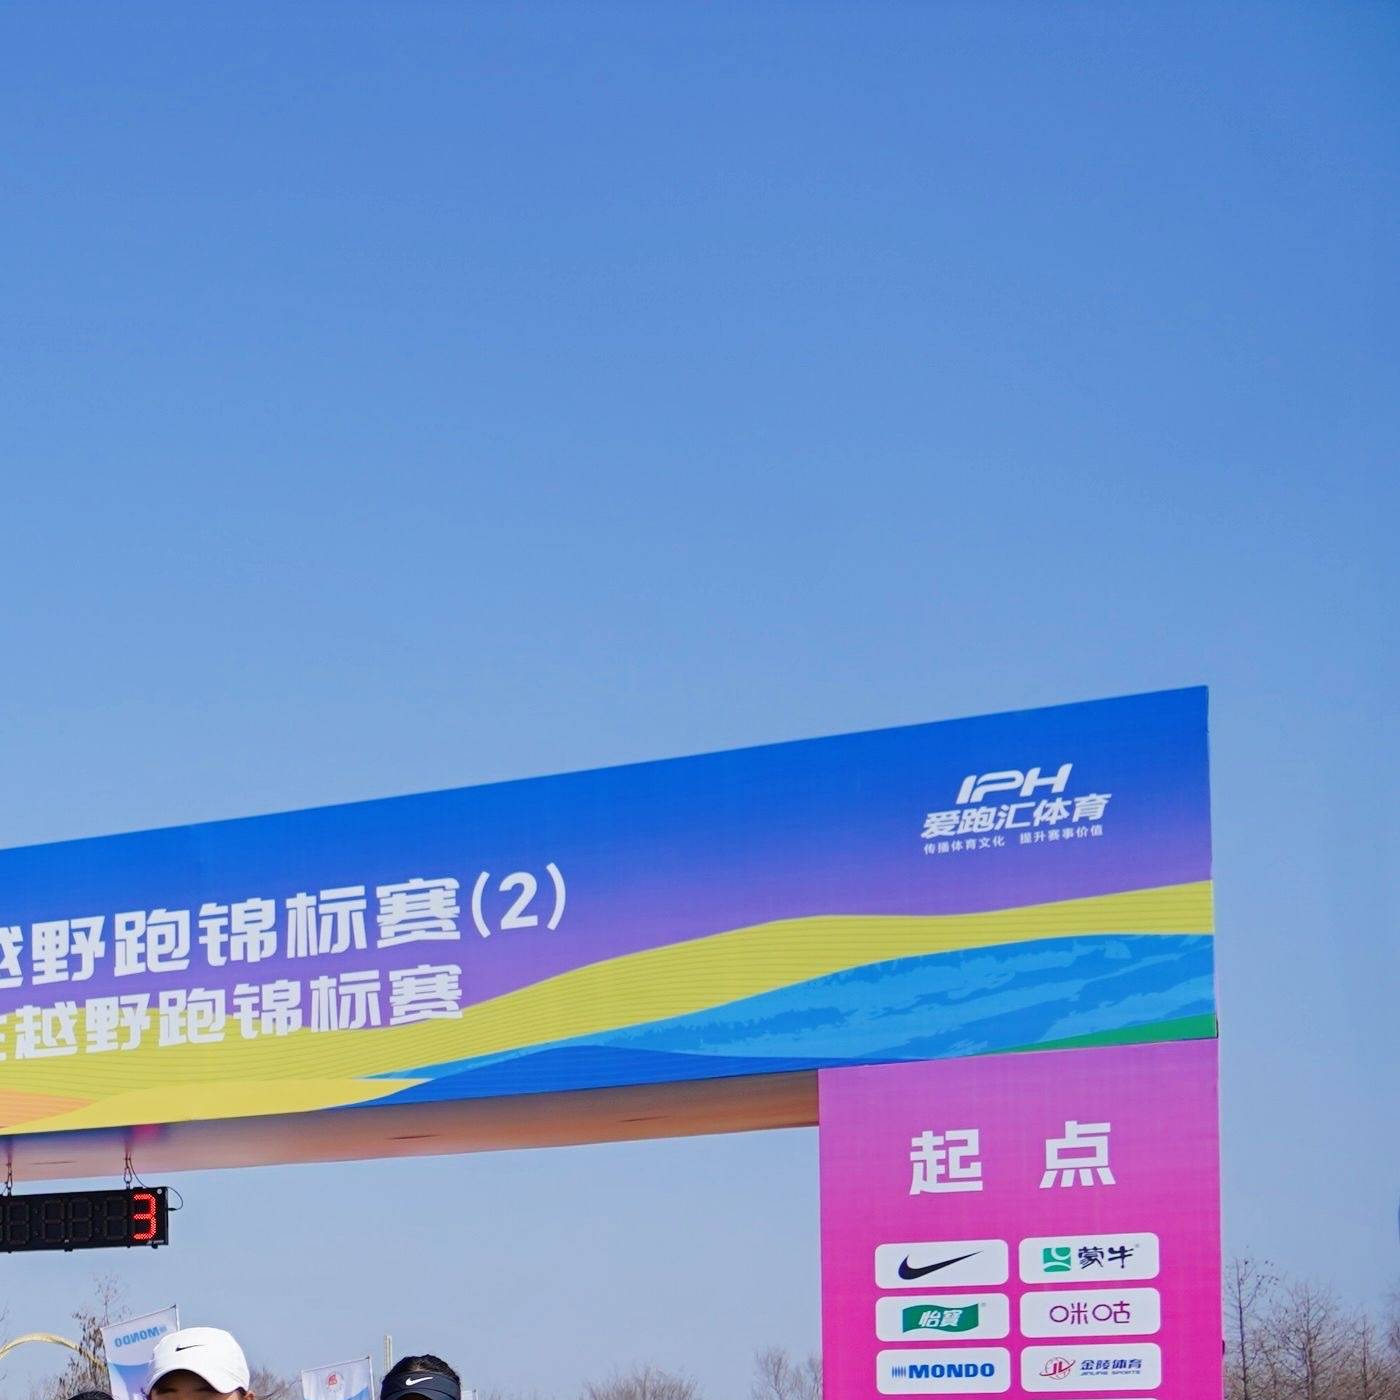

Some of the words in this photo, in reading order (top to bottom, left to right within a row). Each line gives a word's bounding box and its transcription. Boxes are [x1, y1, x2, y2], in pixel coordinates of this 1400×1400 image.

[955, 763, 1073, 805] IPH
[920, 793, 1112, 840] 爱跑汇体育
[909, 1120, 1117, 1196] 起点
[132, 1193, 157, 1241] 3
[1078, 1245, 1134, 1270] 蒙牛
[1049, 1300, 1131, 1325] 咪咕
[908, 1363, 995, 1379] MONDO
[1080, 1358, 1143, 1371] 金陵体育
